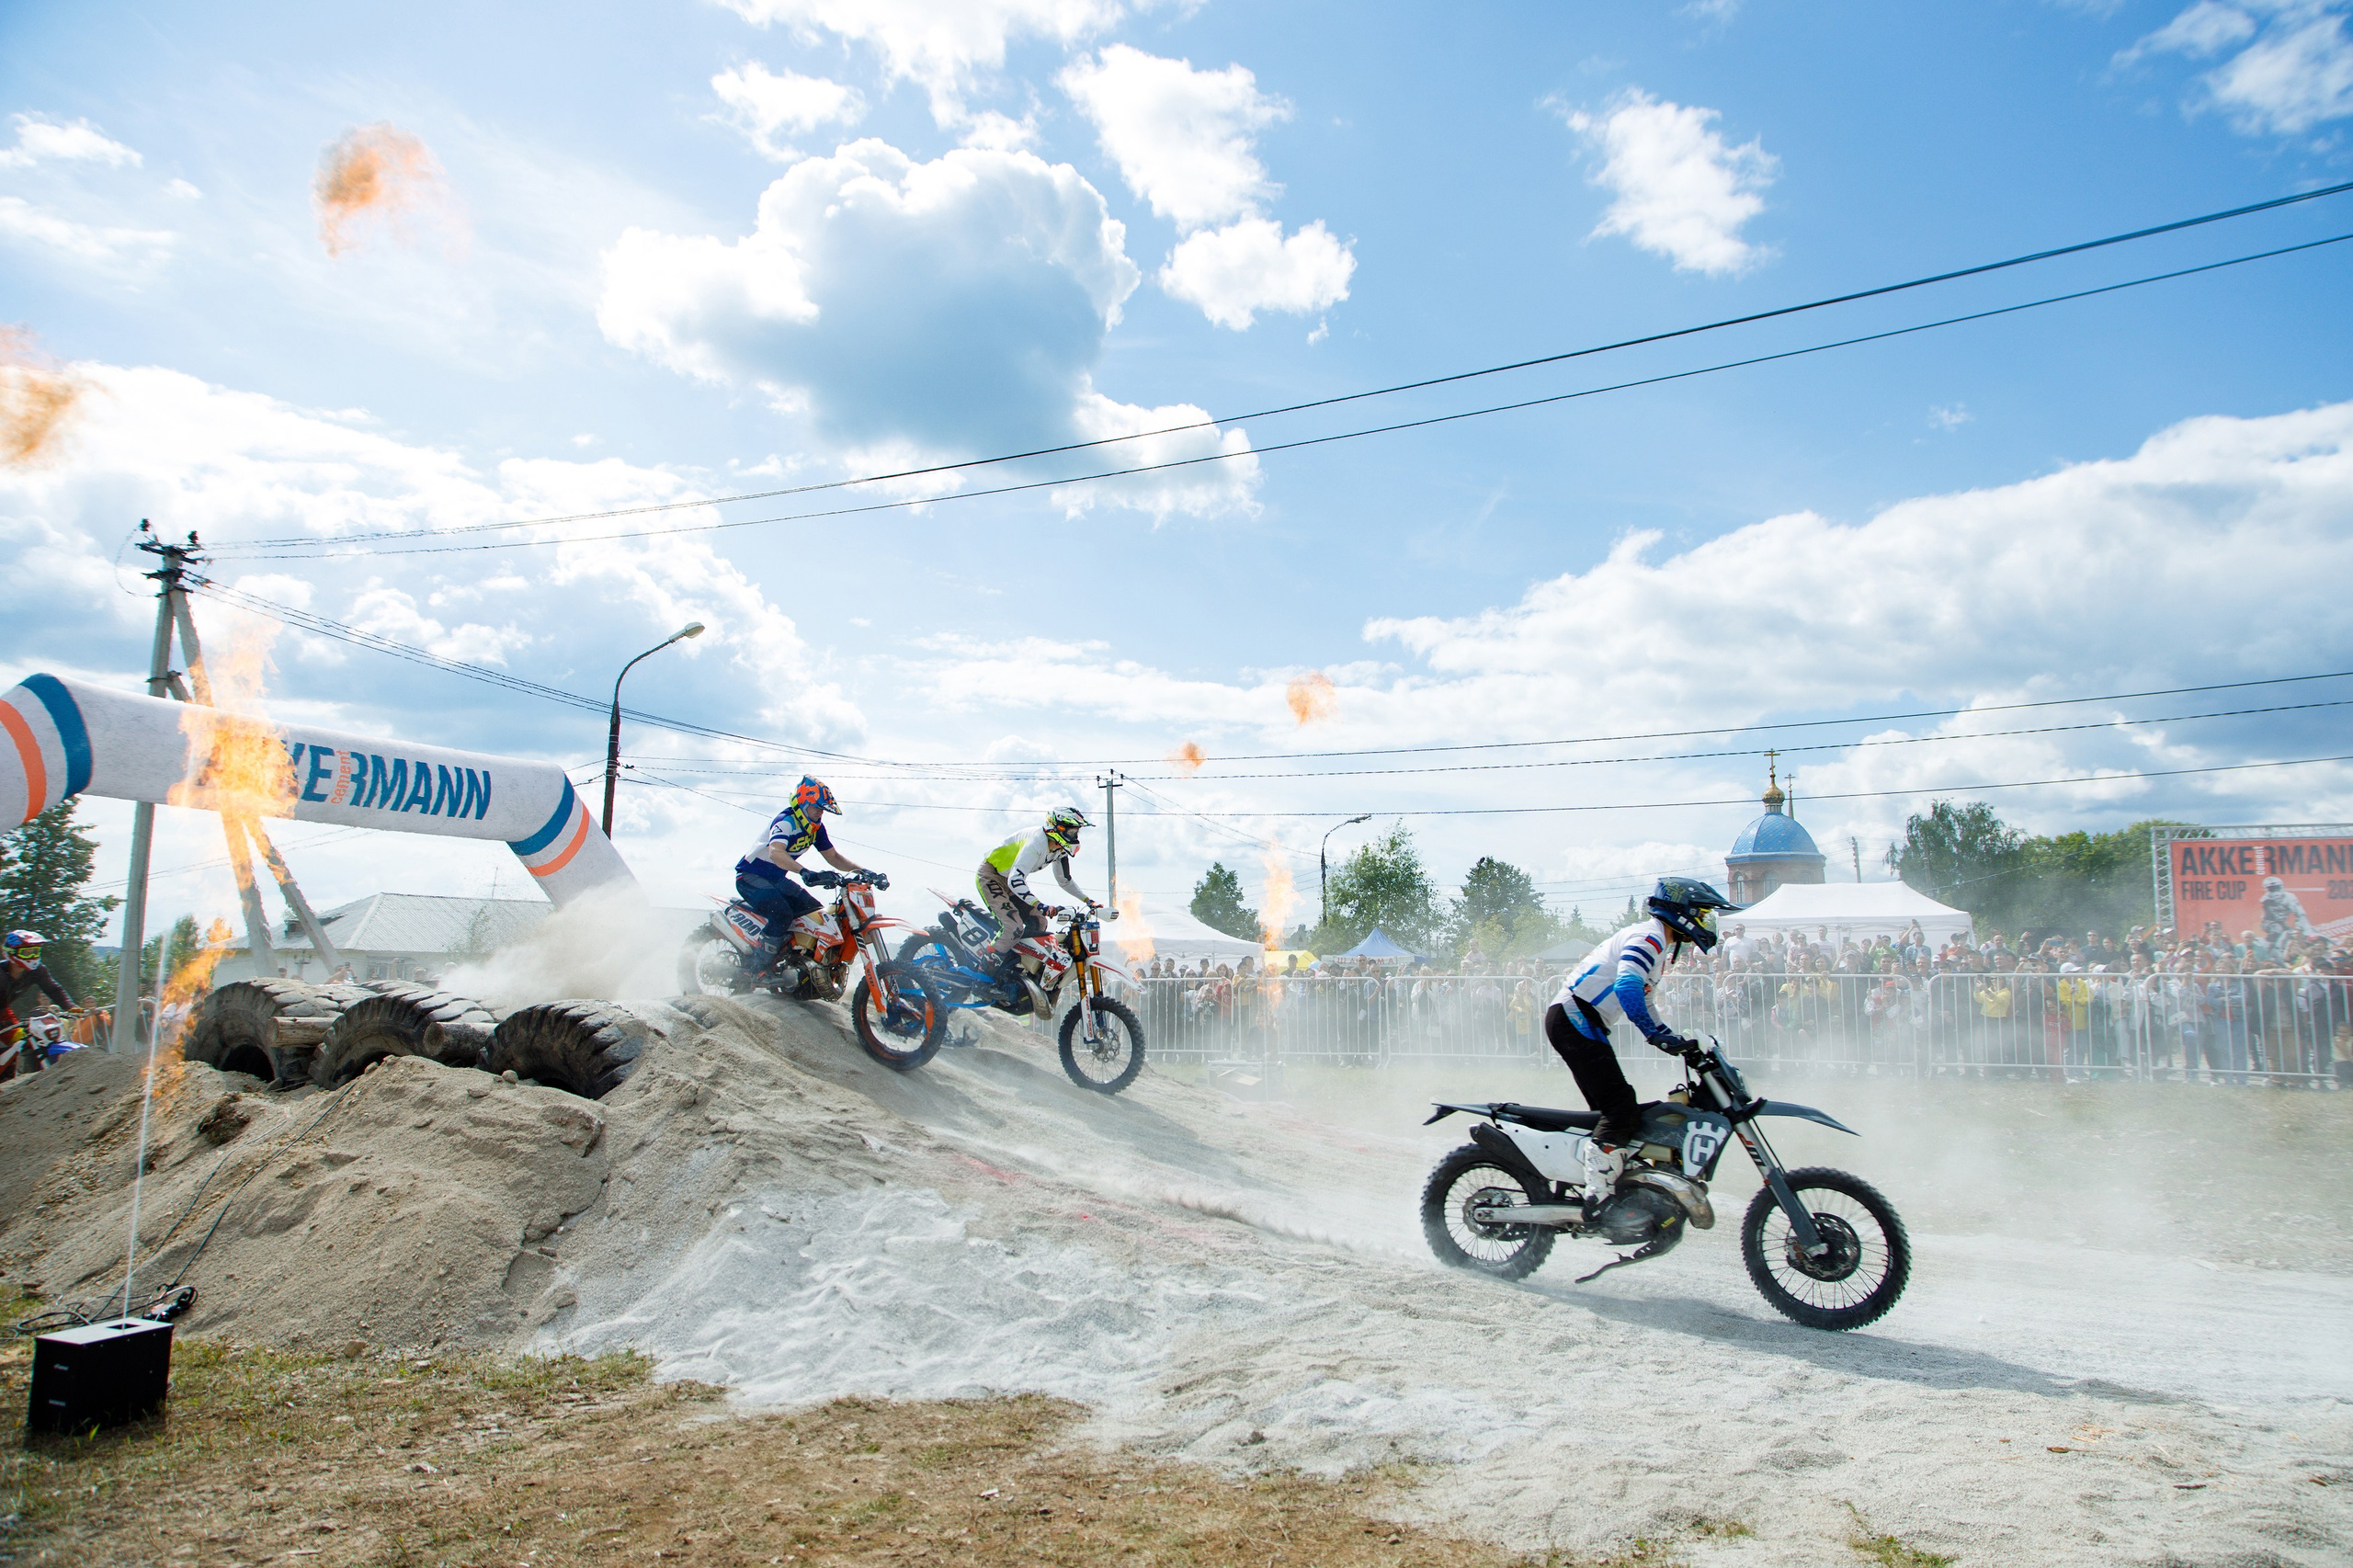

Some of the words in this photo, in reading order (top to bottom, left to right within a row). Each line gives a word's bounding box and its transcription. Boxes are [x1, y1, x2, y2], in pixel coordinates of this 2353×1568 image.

[330, 749, 352, 805] cement
[2181, 881, 2214, 901] FIRE
[2216, 880, 2247, 901] CUP
